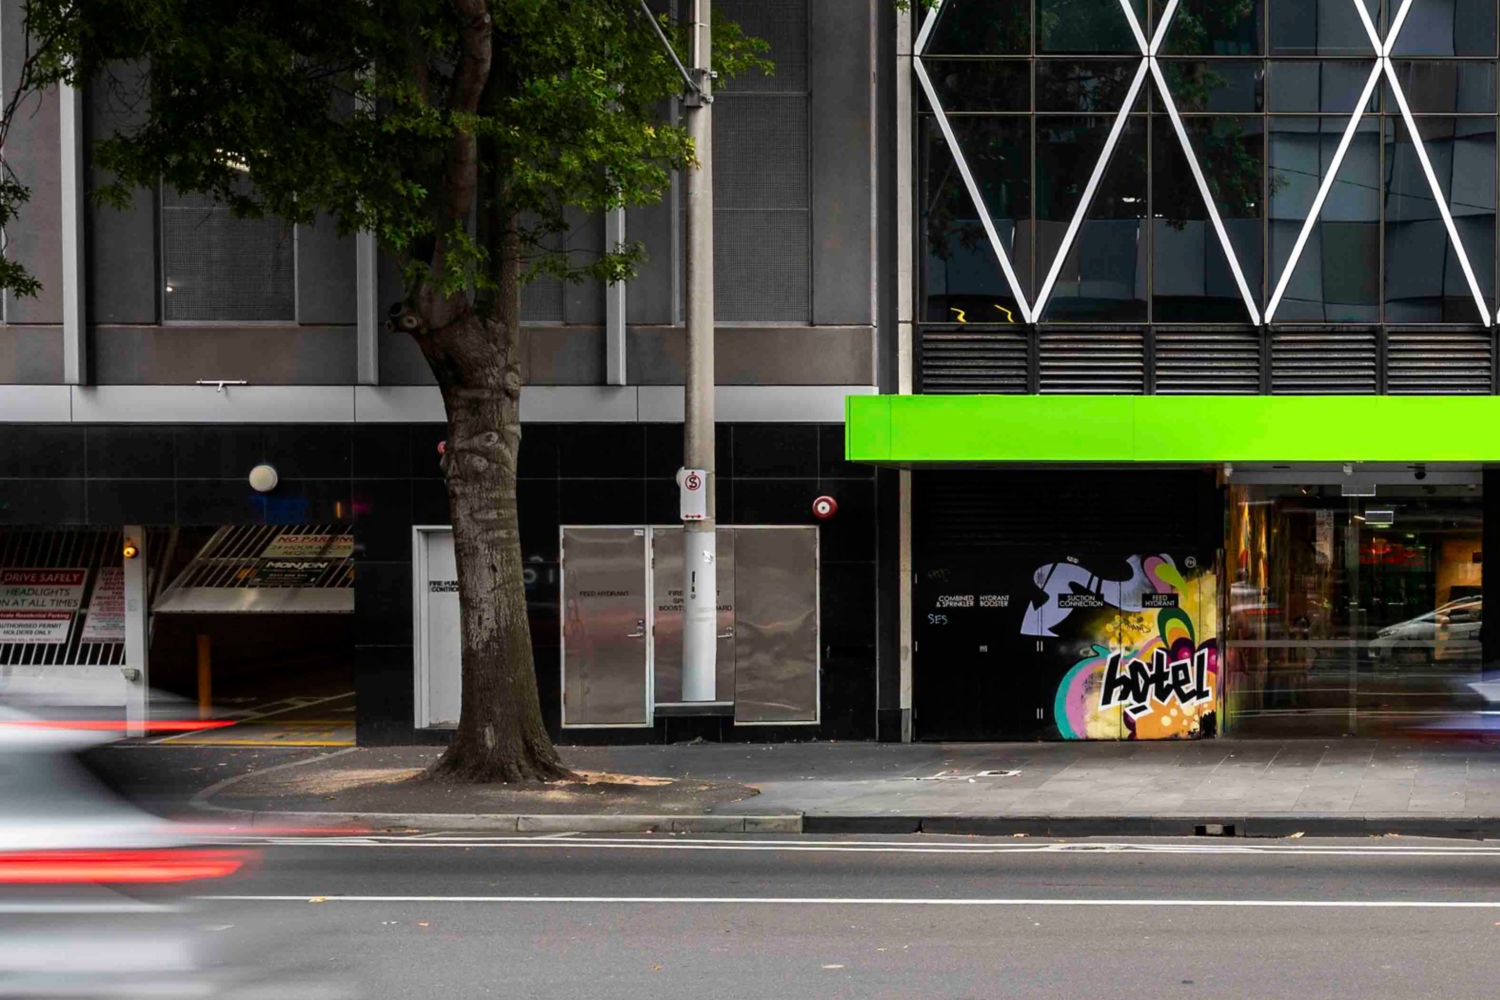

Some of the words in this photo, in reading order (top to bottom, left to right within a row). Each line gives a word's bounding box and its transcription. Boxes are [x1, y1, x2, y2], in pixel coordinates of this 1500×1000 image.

[4, 573, 36, 583] DRIVE
[39, 573, 79, 583] SAFELY
[6, 587, 71, 597] HEADLIGHTS
[12, 599, 26, 608] AT
[28, 599, 47, 608] ALL
[51, 599, 79, 608] TIMES
[1099, 648, 1213, 713] hotel
